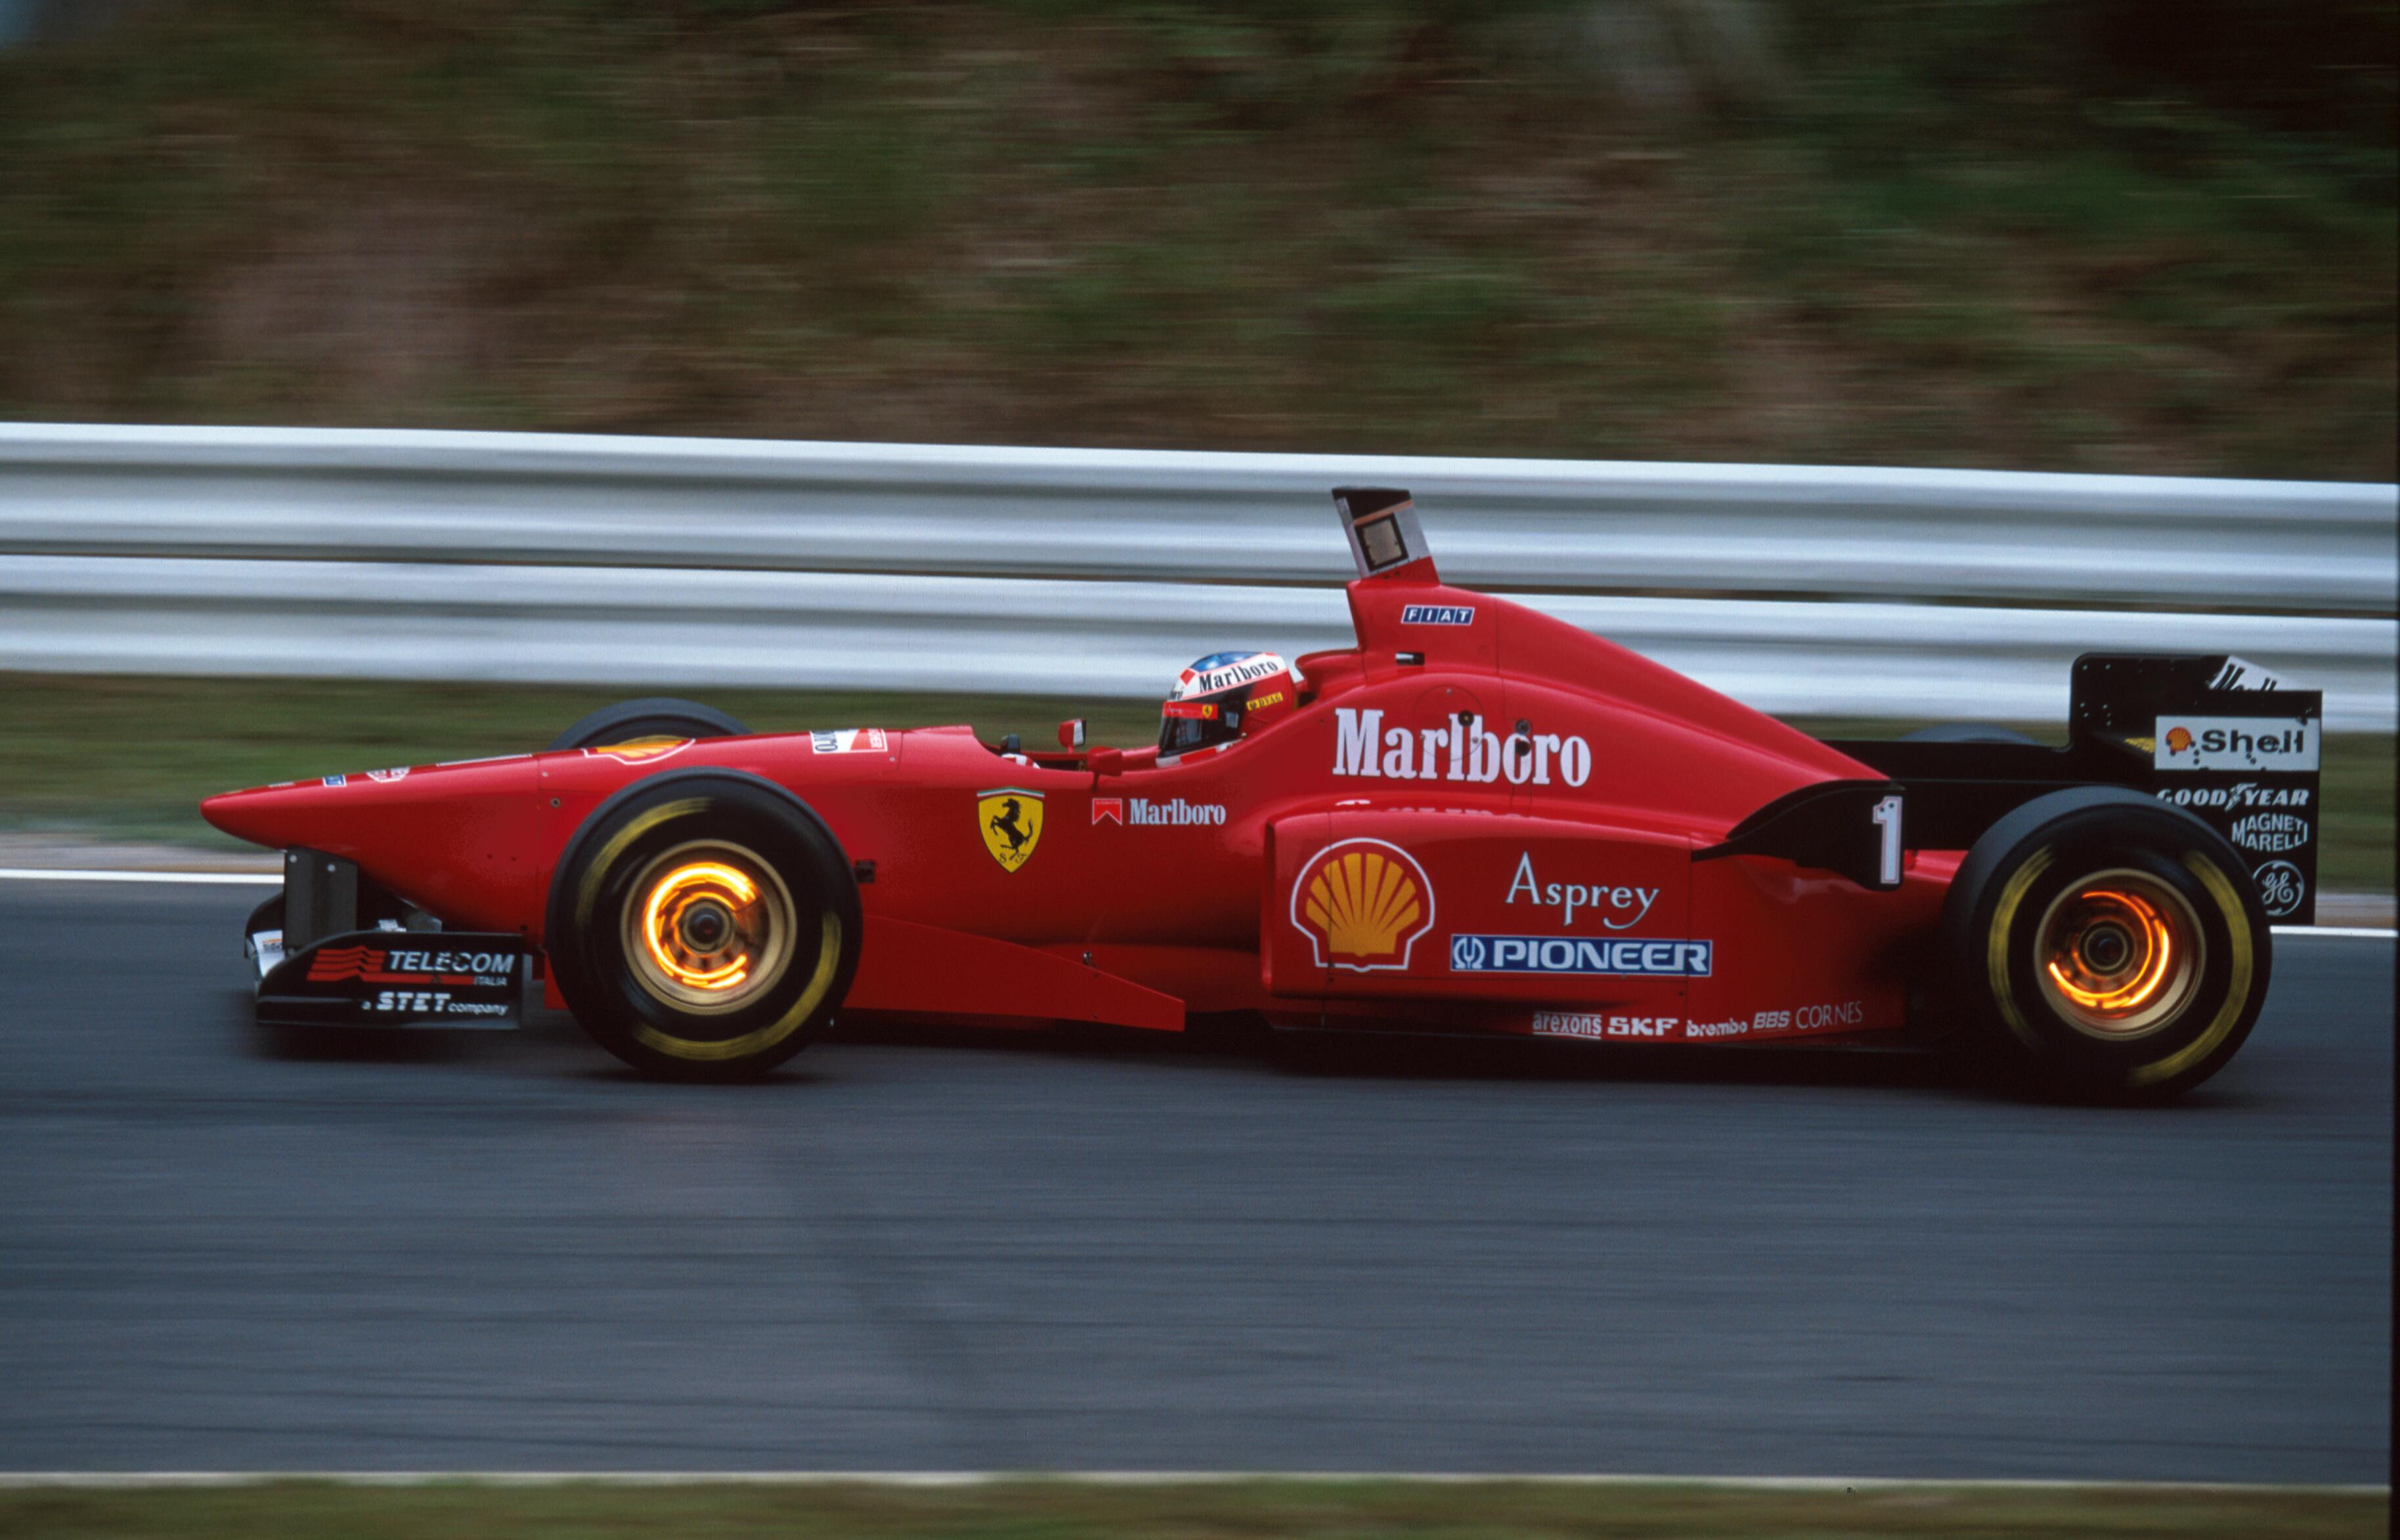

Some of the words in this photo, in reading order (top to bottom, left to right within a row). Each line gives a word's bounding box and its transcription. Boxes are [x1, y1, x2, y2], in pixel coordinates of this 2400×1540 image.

[1407, 608, 1471, 623] FIAT
[1199, 661, 1278, 693] Marlboro
[1332, 708, 1592, 787] Marlboro
[2202, 729, 2303, 753] Shell
[1129, 798, 1226, 825] Marlboro
[2231, 813, 2308, 838] MAGNETI
[1873, 796, 1902, 884] 1
[2232, 828, 2308, 852] MARELLI
[1506, 851, 1660, 930] Asprey
[389, 951, 515, 973] TELECOM
[1493, 940, 1707, 972] PIONEER
[473, 975, 508, 986] ITALIA
[362, 1001, 372, 1010] a
[376, 991, 451, 1012] STET
[448, 1002, 509, 1016] company
[1796, 1000, 1863, 1029] CORNES
[1533, 1013, 1602, 1035] arexons
[1607, 1017, 1678, 1036] SKF
[1686, 1018, 1748, 1037] brembo
[1753, 1011, 1791, 1029] BBS
